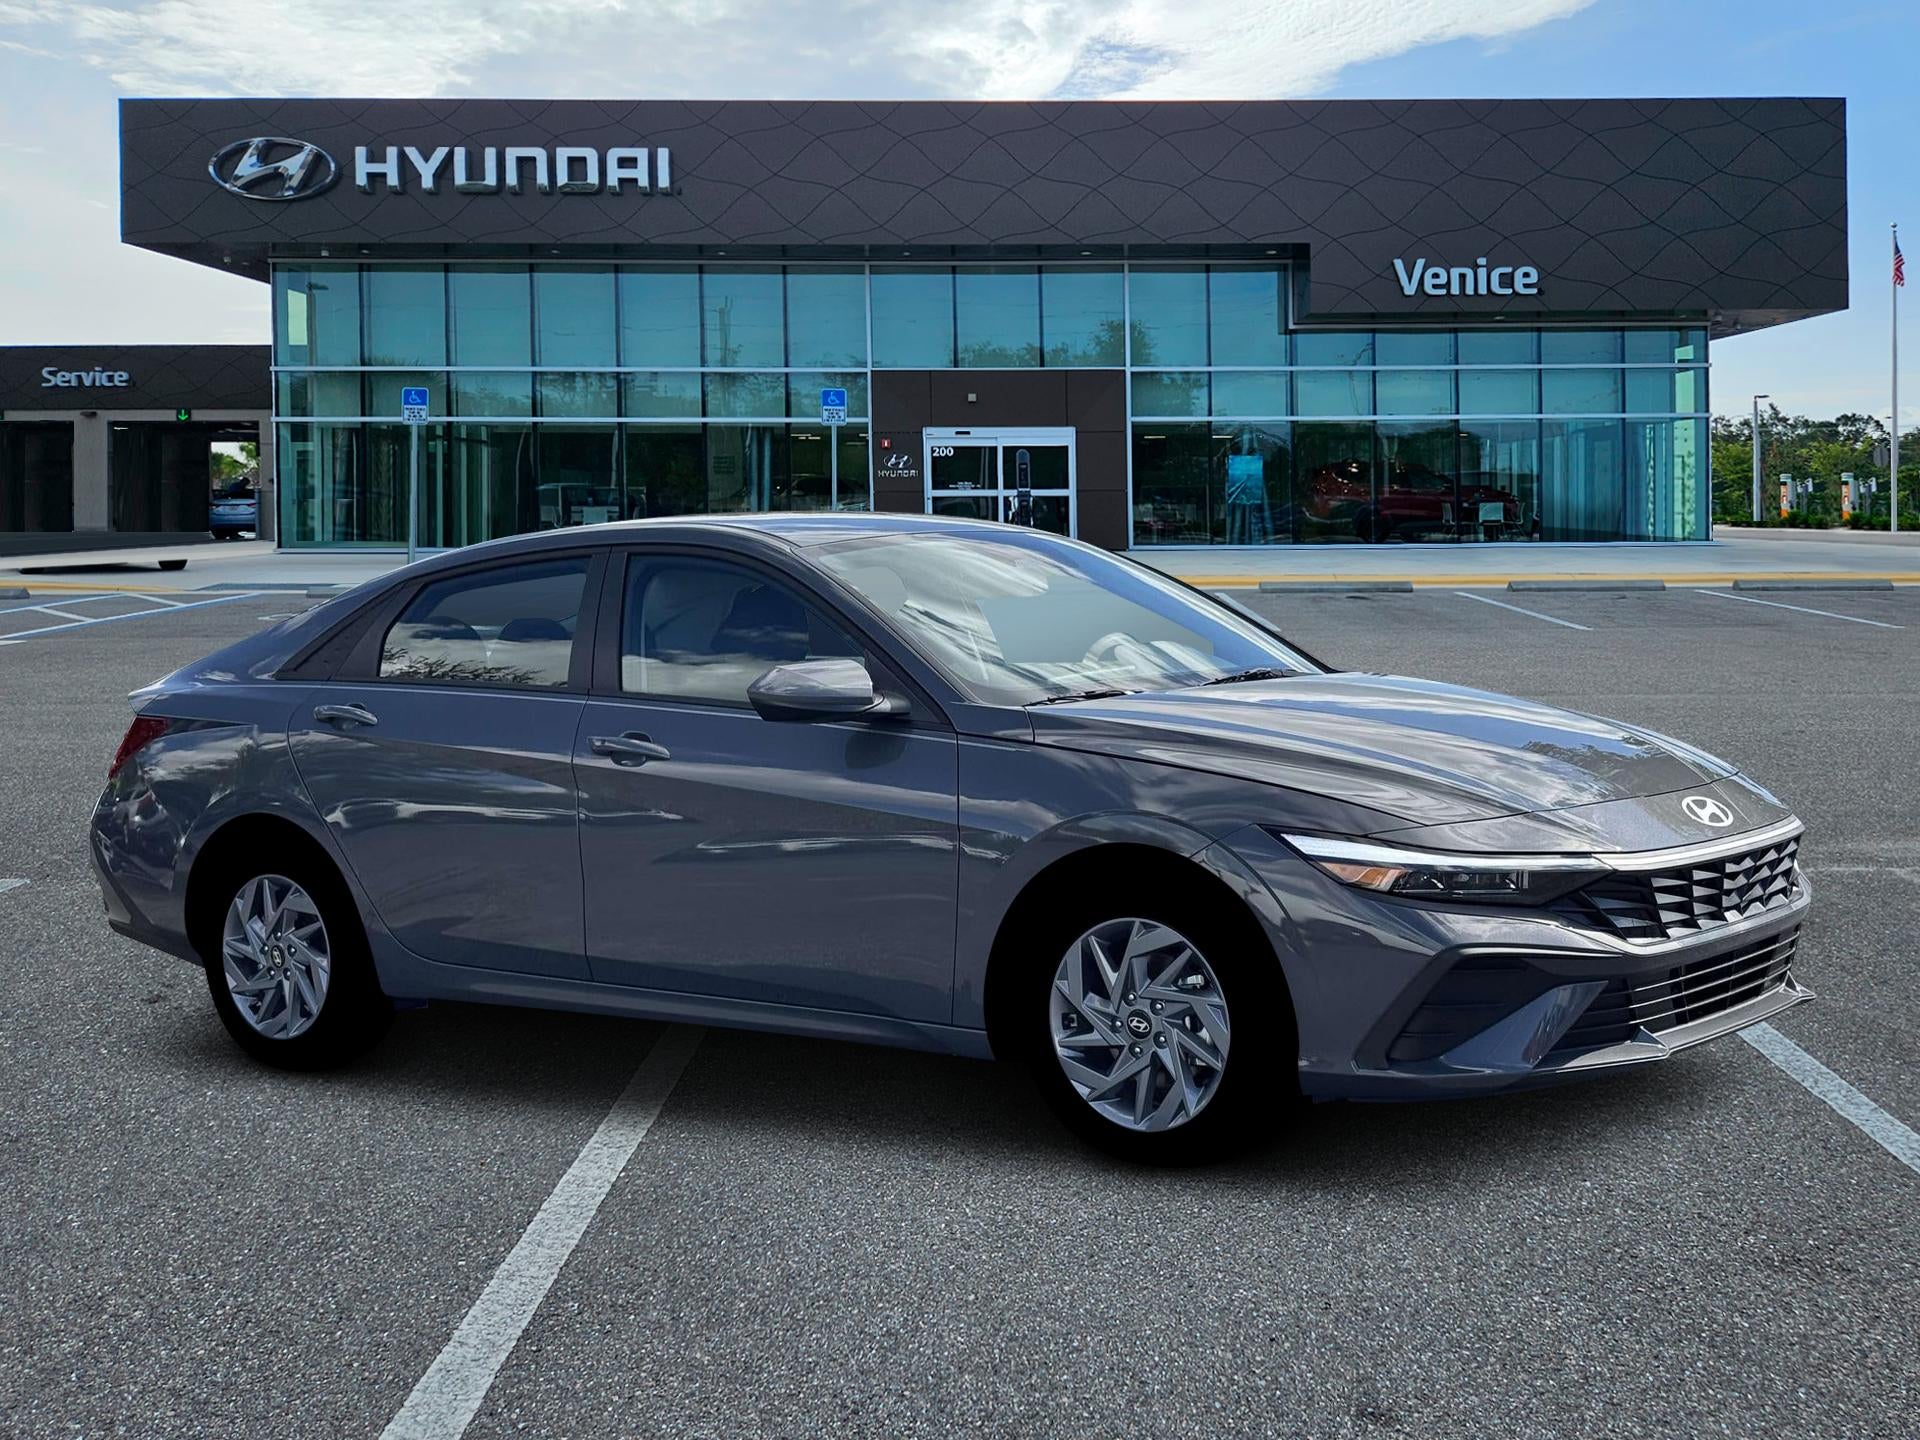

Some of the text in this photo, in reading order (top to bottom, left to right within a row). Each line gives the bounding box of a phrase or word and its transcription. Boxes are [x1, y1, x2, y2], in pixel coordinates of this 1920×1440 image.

[355, 146, 670, 194] HYUNDAI
[1392, 257, 1540, 296] Venice
[41, 366, 130, 387] Service
[932, 446, 954, 457] 200
[878, 469, 919, 478] HYUNDAI
